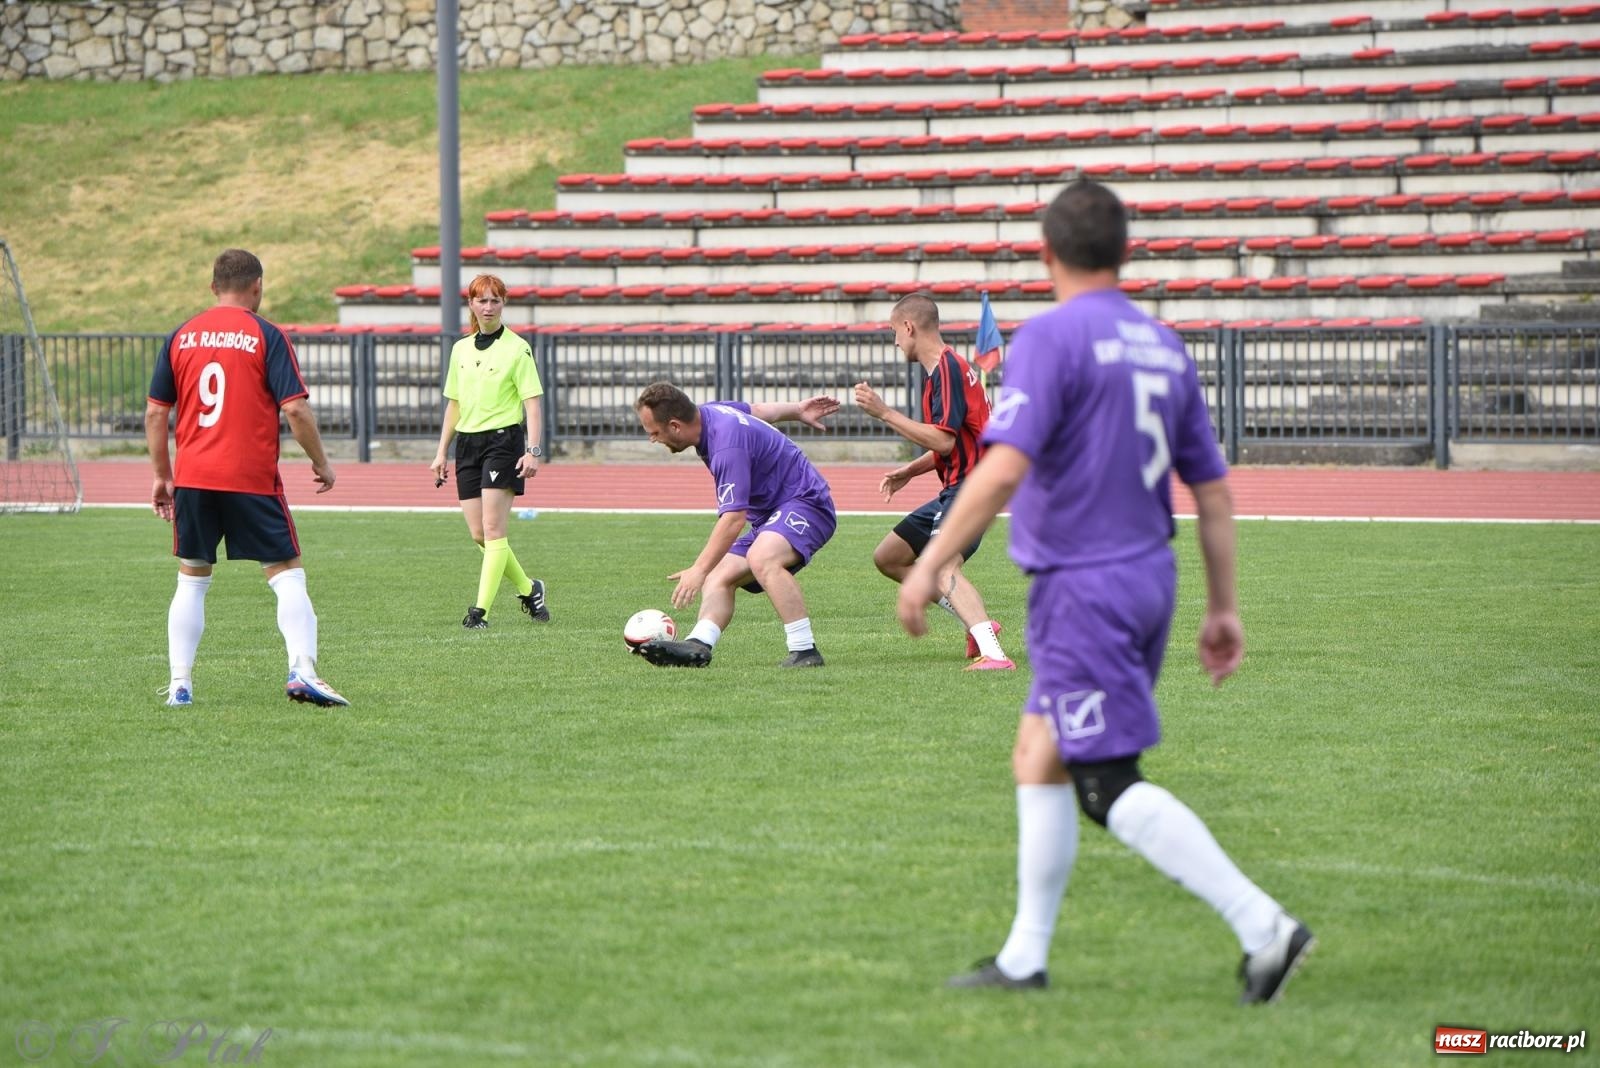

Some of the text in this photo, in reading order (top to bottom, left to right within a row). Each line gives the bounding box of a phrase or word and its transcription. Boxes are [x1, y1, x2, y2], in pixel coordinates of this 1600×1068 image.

[200, 329, 259, 353] RACIBÓRZ
[198, 361, 226, 428] 9
[1132, 370, 1171, 491] 5
